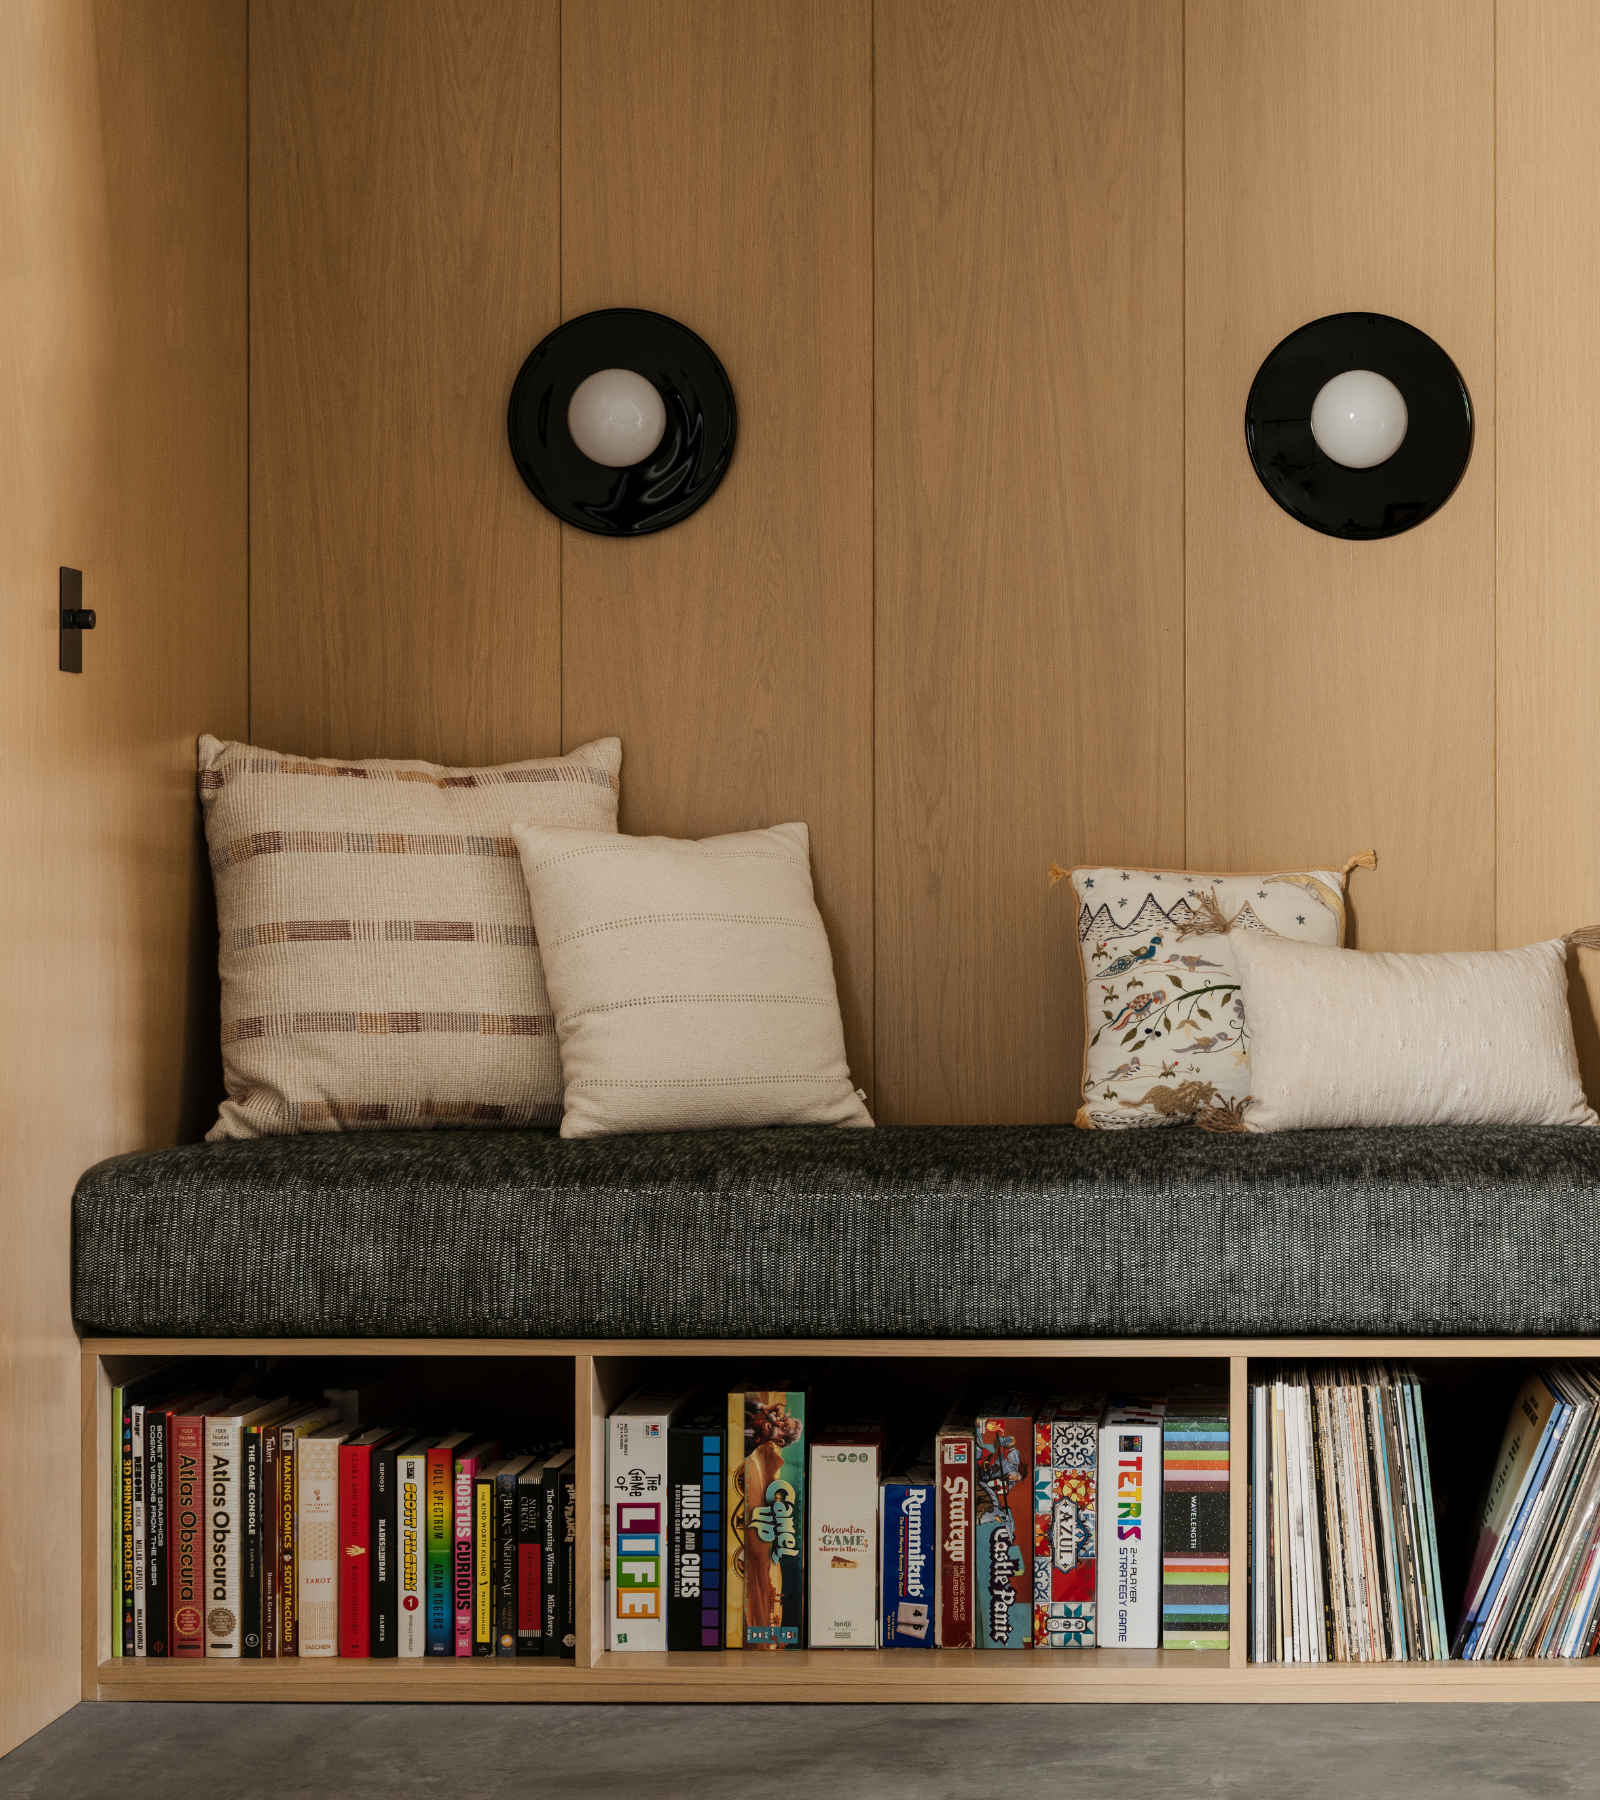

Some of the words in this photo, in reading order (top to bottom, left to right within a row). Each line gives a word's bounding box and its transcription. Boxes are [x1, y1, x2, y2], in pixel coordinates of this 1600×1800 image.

[123, 1459, 132, 1475] 3D
[248, 1445, 256, 1463] THE
[433, 1464, 443, 1486] FULL
[954, 1445, 966, 1462] MB
[179, 1454, 198, 1506] Atlas
[212, 1454, 231, 1506] Atlas
[248, 1464, 256, 1490] GAME
[283, 1455, 292, 1501] MAKING
[546, 1489, 555, 1503] The
[1117, 1456, 1143, 1540] TETRIS
[123, 1478, 133, 1532] PRINTING
[248, 1492, 256, 1535] CONSOLE
[283, 1504, 292, 1548] COMICS
[404, 1483, 418, 1528] SCOTT
[433, 1490, 443, 1539] SPECTRUM
[456, 1474, 471, 1538] HORTUS
[520, 1496, 529, 1532] CIRCUS
[528, 1499, 537, 1529] NIGHT
[681, 1484, 700, 1529] HUES
[765, 1480, 800, 1564] Camel
[943, 1476, 969, 1563] Stratego
[378, 1519, 386, 1546] BLADES
[545, 1504, 555, 1551] Cooperating
[674, 1535, 681, 1543] OF
[684, 1531, 696, 1550] AND
[821, 1524, 866, 1535] Observation
[822, 1535, 864, 1546] GAME
[901, 1488, 926, 1597] Rummikub
[1059, 1510, 1073, 1559] AZUL
[124, 1534, 133, 1592] PROJECTS
[179, 1510, 199, 1601] Obscura
[212, 1510, 231, 1601] Obscura
[378, 1562, 386, 1582] DARK
[404, 1530, 418, 1591] PILGRIM
[433, 1564, 443, 1588] ADAM
[456, 1541, 471, 1610] CURIOUS
[501, 1538, 513, 1597] NIGHTINGALE
[546, 1552, 555, 1584] Witness
[619, 1505, 658, 1616] LIFE
[681, 1553, 700, 1598] CUES
[992, 1528, 1018, 1584] Castle
[1119, 1547, 1127, 1606] STRATEGY
[1129, 1547, 1137, 1564] 2-4
[284, 1565, 292, 1595] SCOTT
[1129, 1567, 1138, 1603] PLAYER
[284, 1597, 292, 1642] McCLOUD
[408, 1598, 413, 1608] 1
[433, 1594, 443, 1629] ROGERS
[547, 1594, 555, 1614] Mike
[959, 1612, 965, 1621] OF
[992, 1589, 1015, 1641] Panic
[545, 1615, 554, 1637] Avery
[1119, 1610, 1127, 1642] GAME
